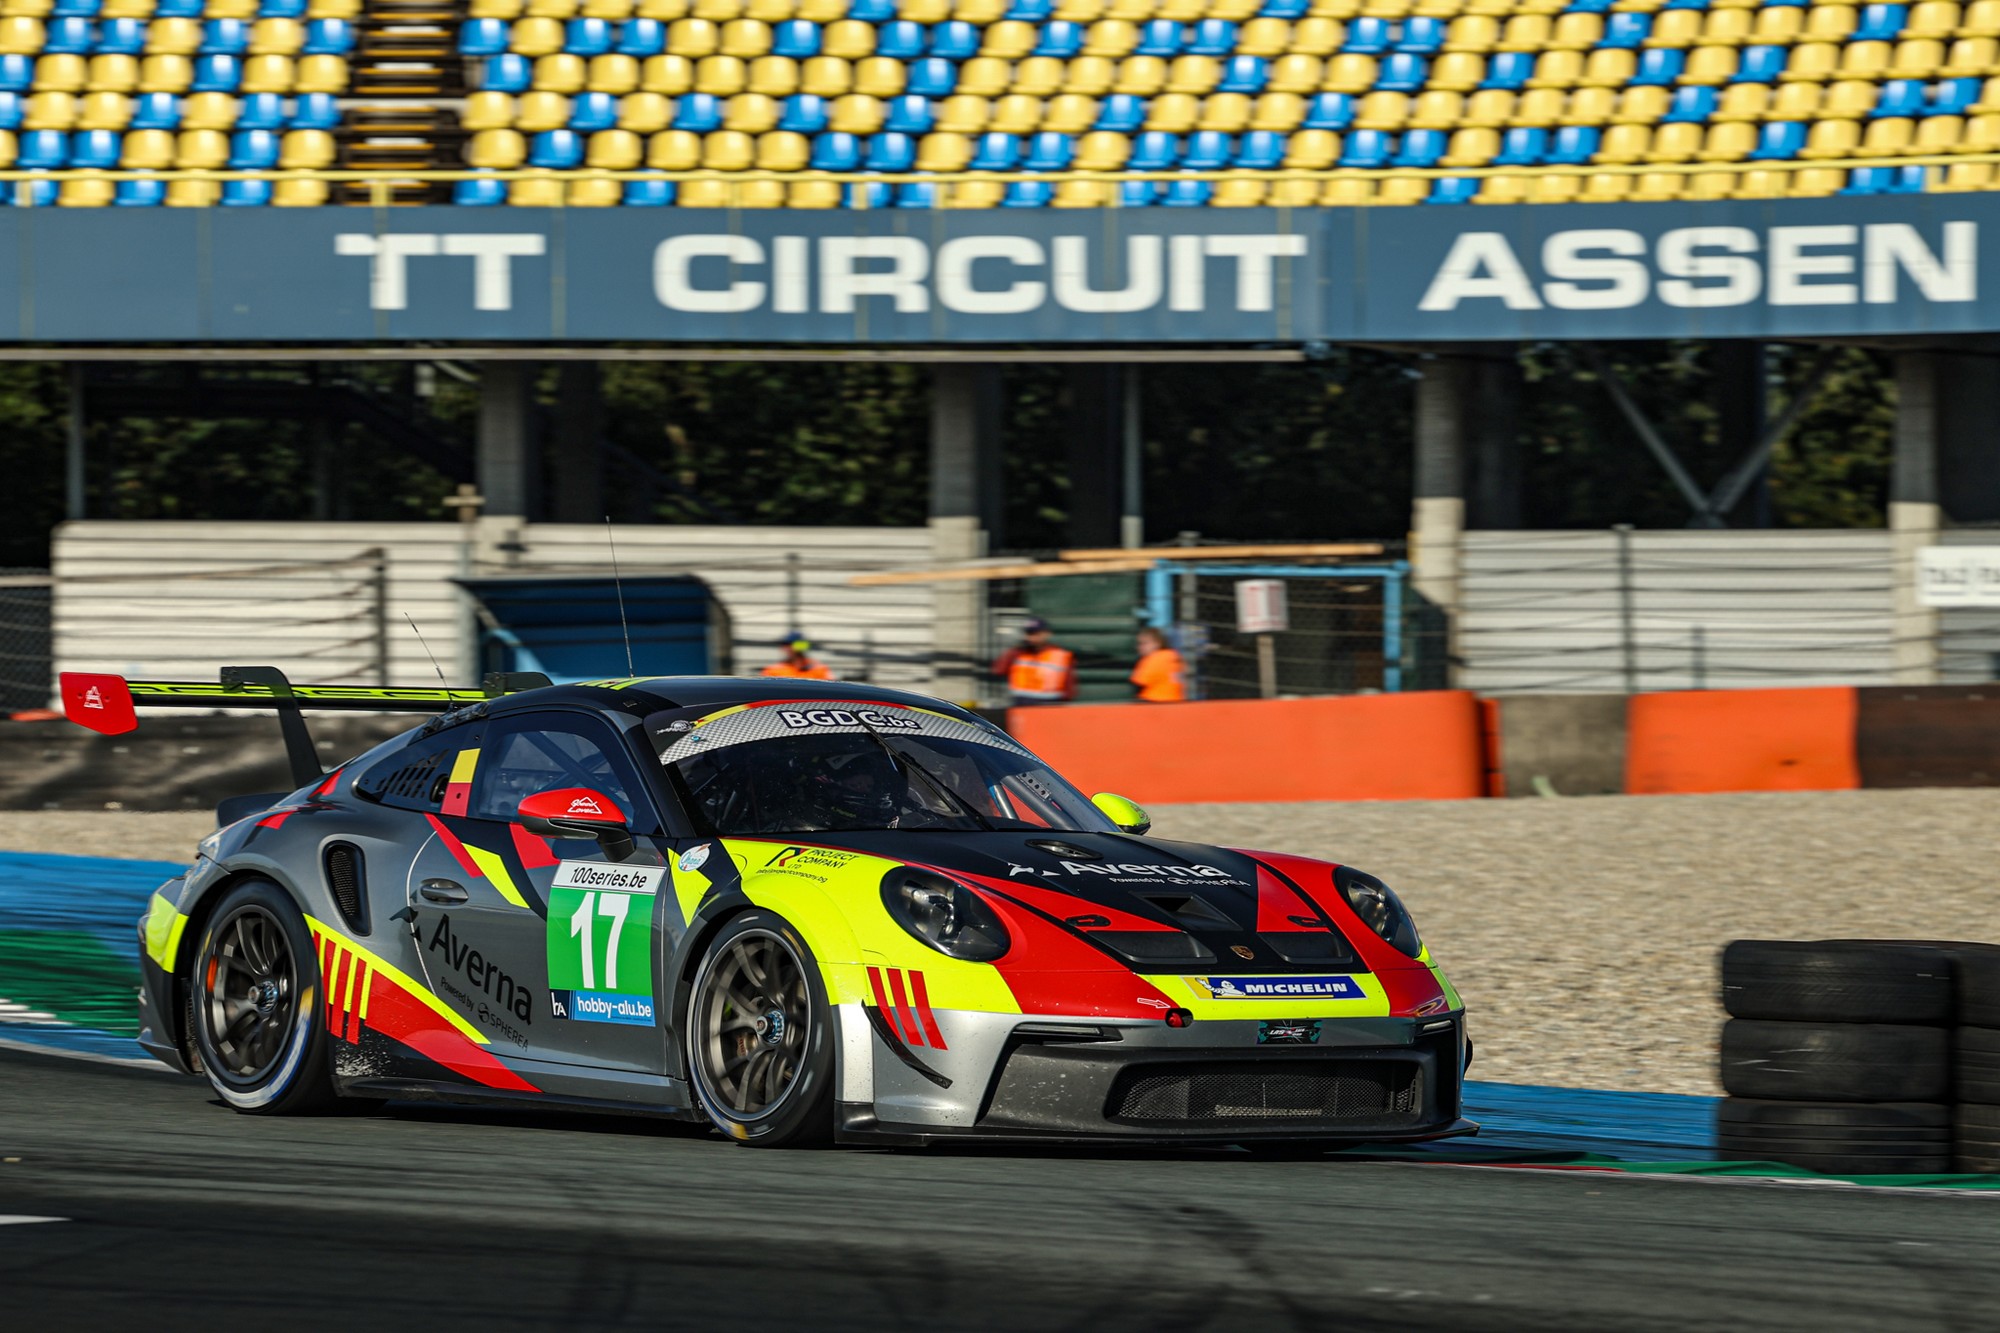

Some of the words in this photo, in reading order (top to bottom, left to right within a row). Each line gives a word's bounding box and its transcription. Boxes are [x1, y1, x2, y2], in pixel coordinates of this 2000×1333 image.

[334, 233, 545, 310] TT
[653, 234, 1307, 313] CIRCUIT
[1418, 221, 1978, 311] ASSEN
[797, 856, 847, 869] COMPANY
[808, 848, 859, 861] PROJECT
[570, 867, 648, 888] 100series.be
[1059, 860, 1232, 877] Averna
[1187, 879, 1251, 887] SPHEREA
[570, 891, 631, 990] 17
[429, 913, 532, 1026] Averna
[1245, 983, 1348, 993] MICHELIN
[440, 976, 467, 1004] Powered
[466, 994, 475, 1012] by
[490, 1013, 529, 1053] SPHEREA
[577, 995, 652, 1019] hobby-alu.be
